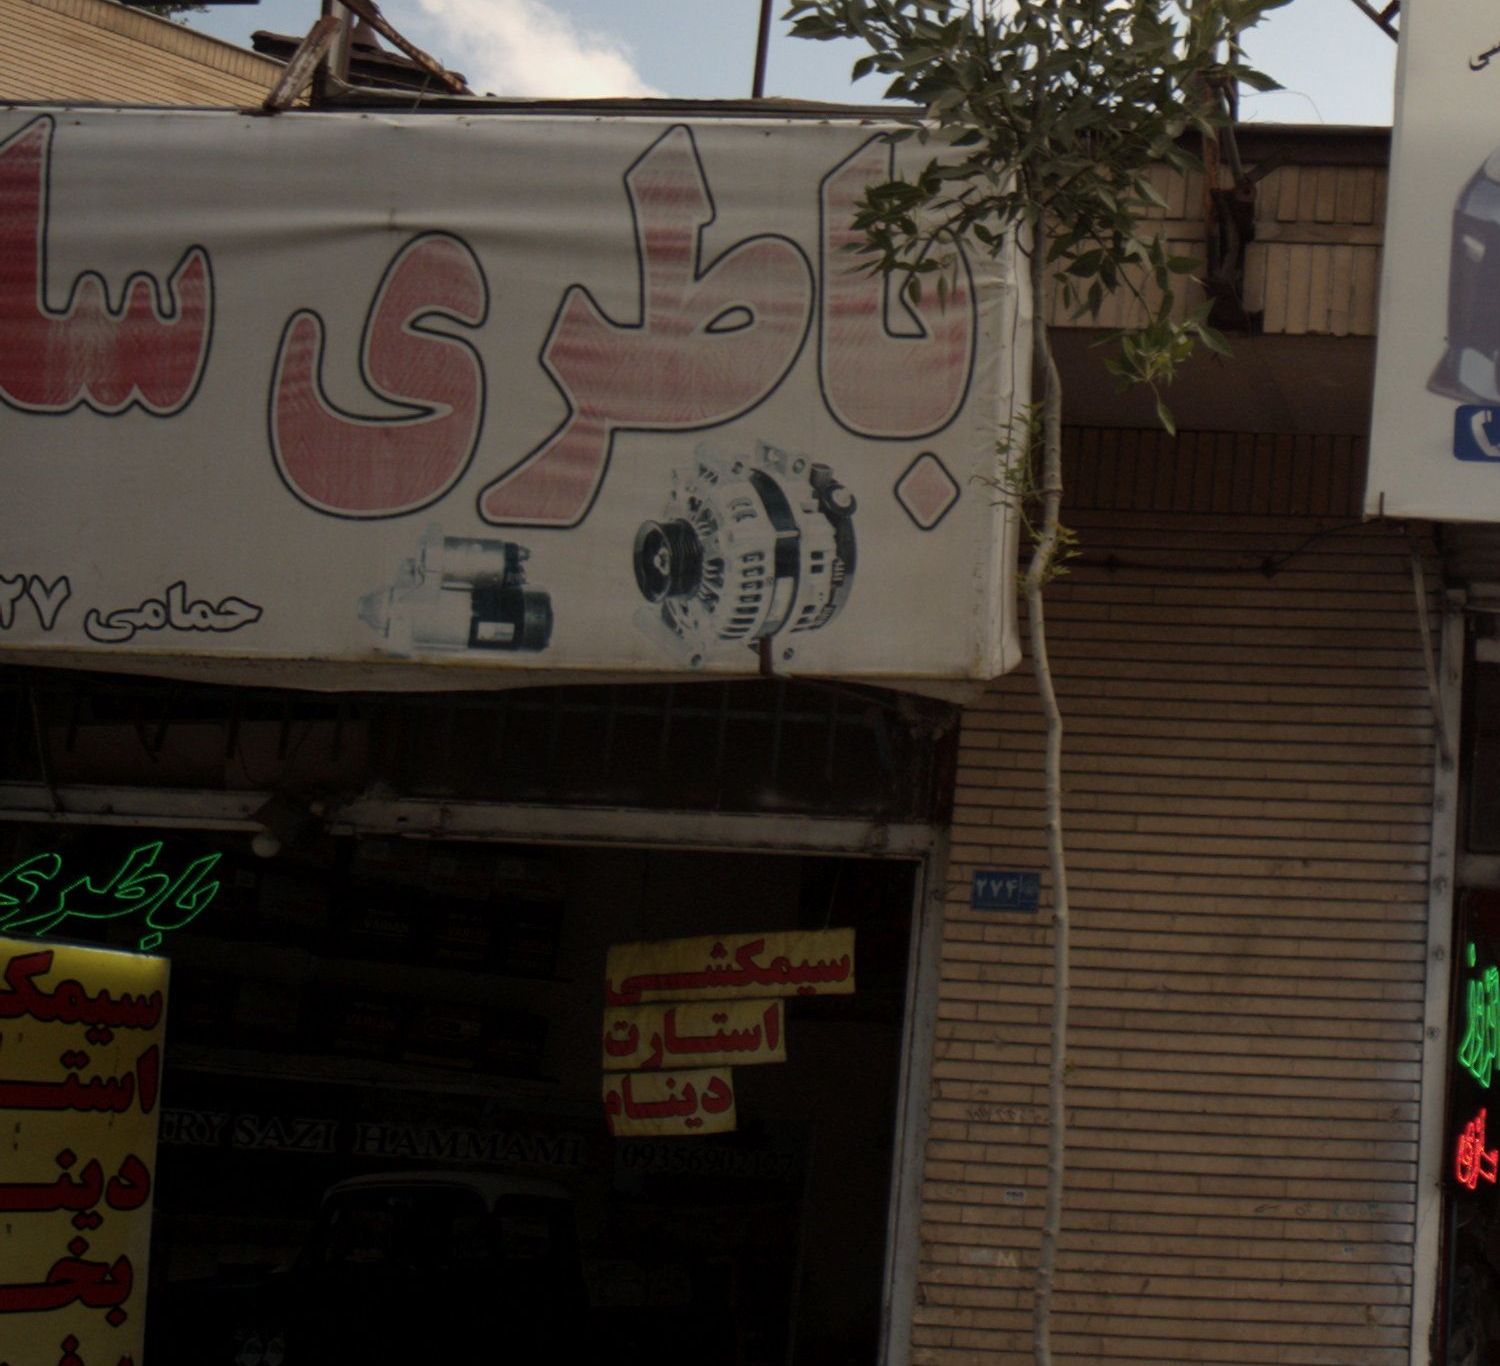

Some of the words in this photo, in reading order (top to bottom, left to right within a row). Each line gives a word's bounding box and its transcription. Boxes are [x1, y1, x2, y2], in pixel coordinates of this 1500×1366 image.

[267, 123, 979, 529] باطری
[84, 580, 263, 644] حمامی
[606, 937, 851, 1006] سیمکشی
[604, 1001, 781, 1070] استارت
[602, 1074, 733, 1136] دینام
[233, 1114, 337, 1153] SAZI
[353, 1122, 586, 1165] HAMMAMI
